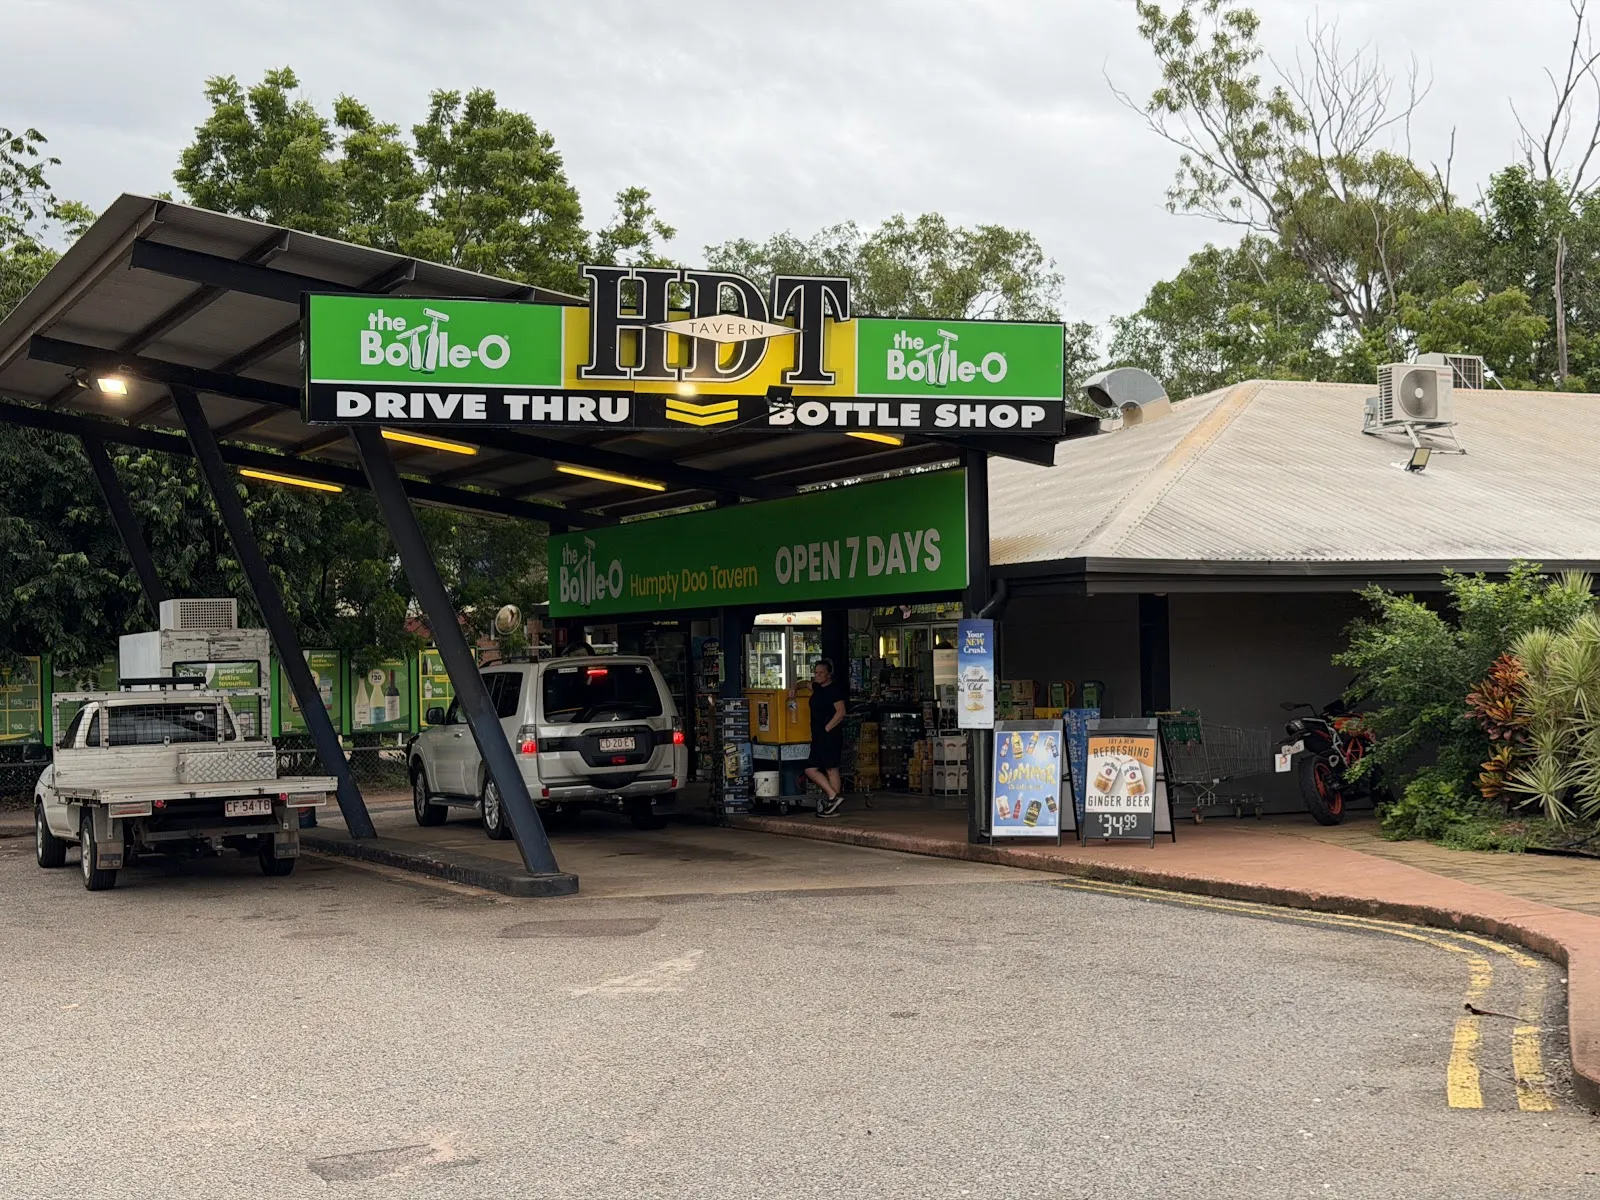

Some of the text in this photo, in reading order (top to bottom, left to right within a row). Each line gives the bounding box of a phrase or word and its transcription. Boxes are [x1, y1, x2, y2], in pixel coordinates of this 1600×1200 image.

[368, 309, 406, 331] the
[578, 264, 851, 385] HDT
[688, 322, 764, 336] TAVERN
[893, 330, 924, 350] the
[336, 391, 630, 422] DRIVE THRU
[768, 401, 1046, 428] BOTTLE SHOP
[562, 542, 578, 565] the
[774, 527, 942, 586] OPEN 7 DAYS
[630, 565, 758, 604] Humpty Doo Tavern
[966, 630, 985, 638] Your
[966, 638, 985, 646] NEW
[1093, 745, 1150, 758] REFRESHING
[1088, 796, 1150, 807] GINGER BEER
